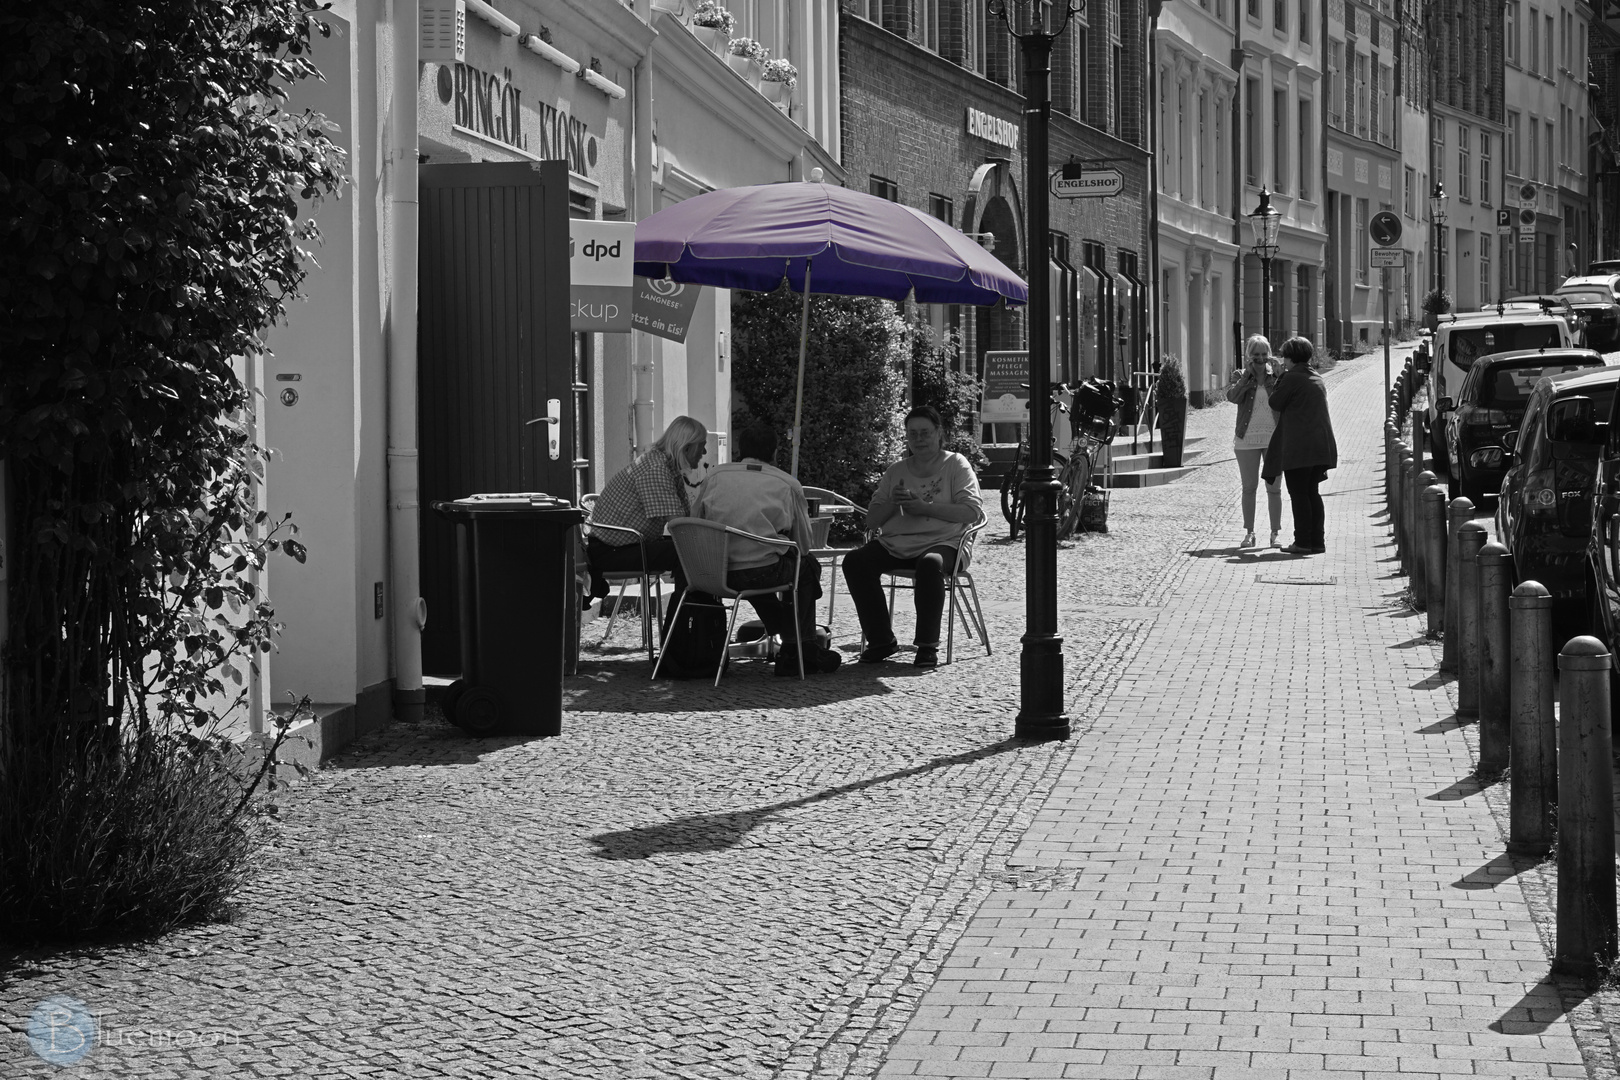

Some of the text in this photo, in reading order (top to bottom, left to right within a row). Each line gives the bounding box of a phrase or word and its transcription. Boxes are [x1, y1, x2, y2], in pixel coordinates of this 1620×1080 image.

[454, 63, 588, 177] BINGÖL KIOSK
[967, 107, 1019, 149] ENGELSHOF
[1057, 178, 1119, 188] ENGELSHOF
[1500, 212, 1507, 224] P
[583, 239, 620, 261] dpd
[640, 291, 679, 309] LANGNESE
[651, 319, 665, 330] ein
[667, 323, 683, 335] Eis!
[1561, 490, 1581, 499] FOX
